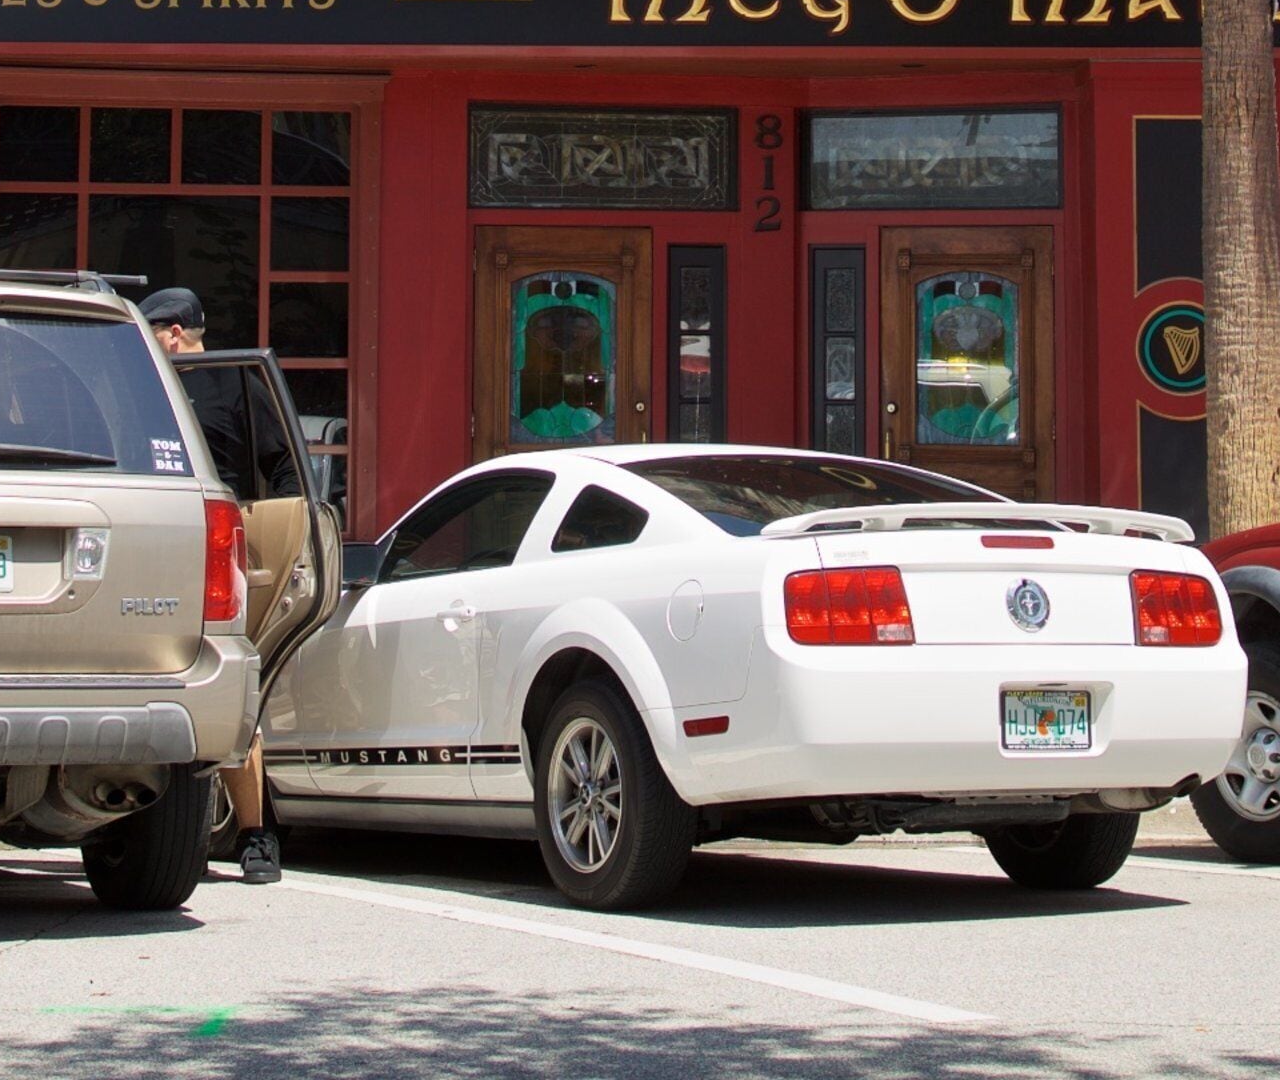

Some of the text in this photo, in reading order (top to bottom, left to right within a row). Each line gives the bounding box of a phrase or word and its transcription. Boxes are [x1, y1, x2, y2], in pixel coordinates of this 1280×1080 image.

[151, 439, 181, 451] TOM
[155, 460, 184, 471] DAN
[121, 598, 179, 615] PILOT
[320, 748, 452, 764] MUSTANG
